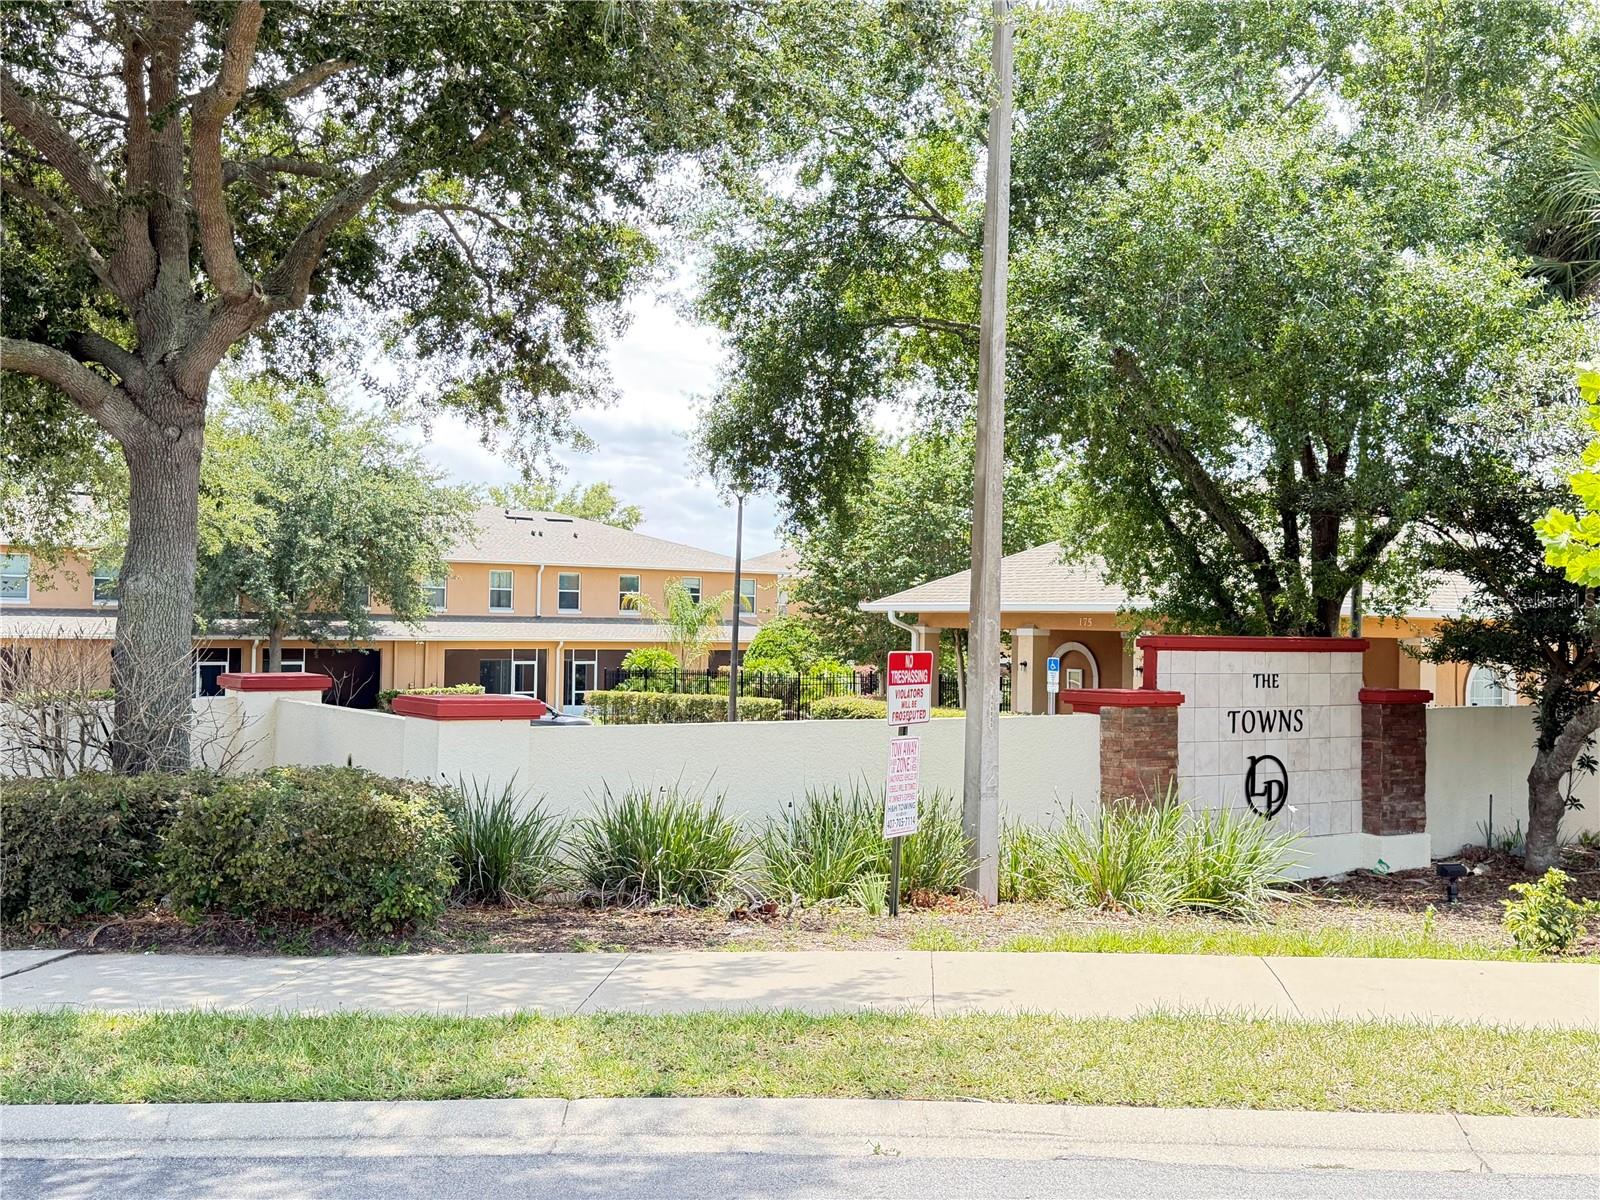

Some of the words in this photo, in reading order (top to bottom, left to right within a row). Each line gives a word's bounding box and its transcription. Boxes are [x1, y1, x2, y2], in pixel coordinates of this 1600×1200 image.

[1079, 617, 1093, 627] 175
[905, 654, 914, 668] NO
[891, 669, 928, 684] TRESPASSING
[1253, 673, 1280, 689] THE
[895, 688, 924, 700] VIOLATORS
[901, 700, 911, 709] WILL
[911, 700, 917, 708] BE
[1227, 709, 1304, 734] TOWNS
[892, 742, 902, 757] TOW
[902, 740, 917, 756] AWAY
[896, 757, 910, 773] ZONE
[898, 802, 915, 811] TOWING
